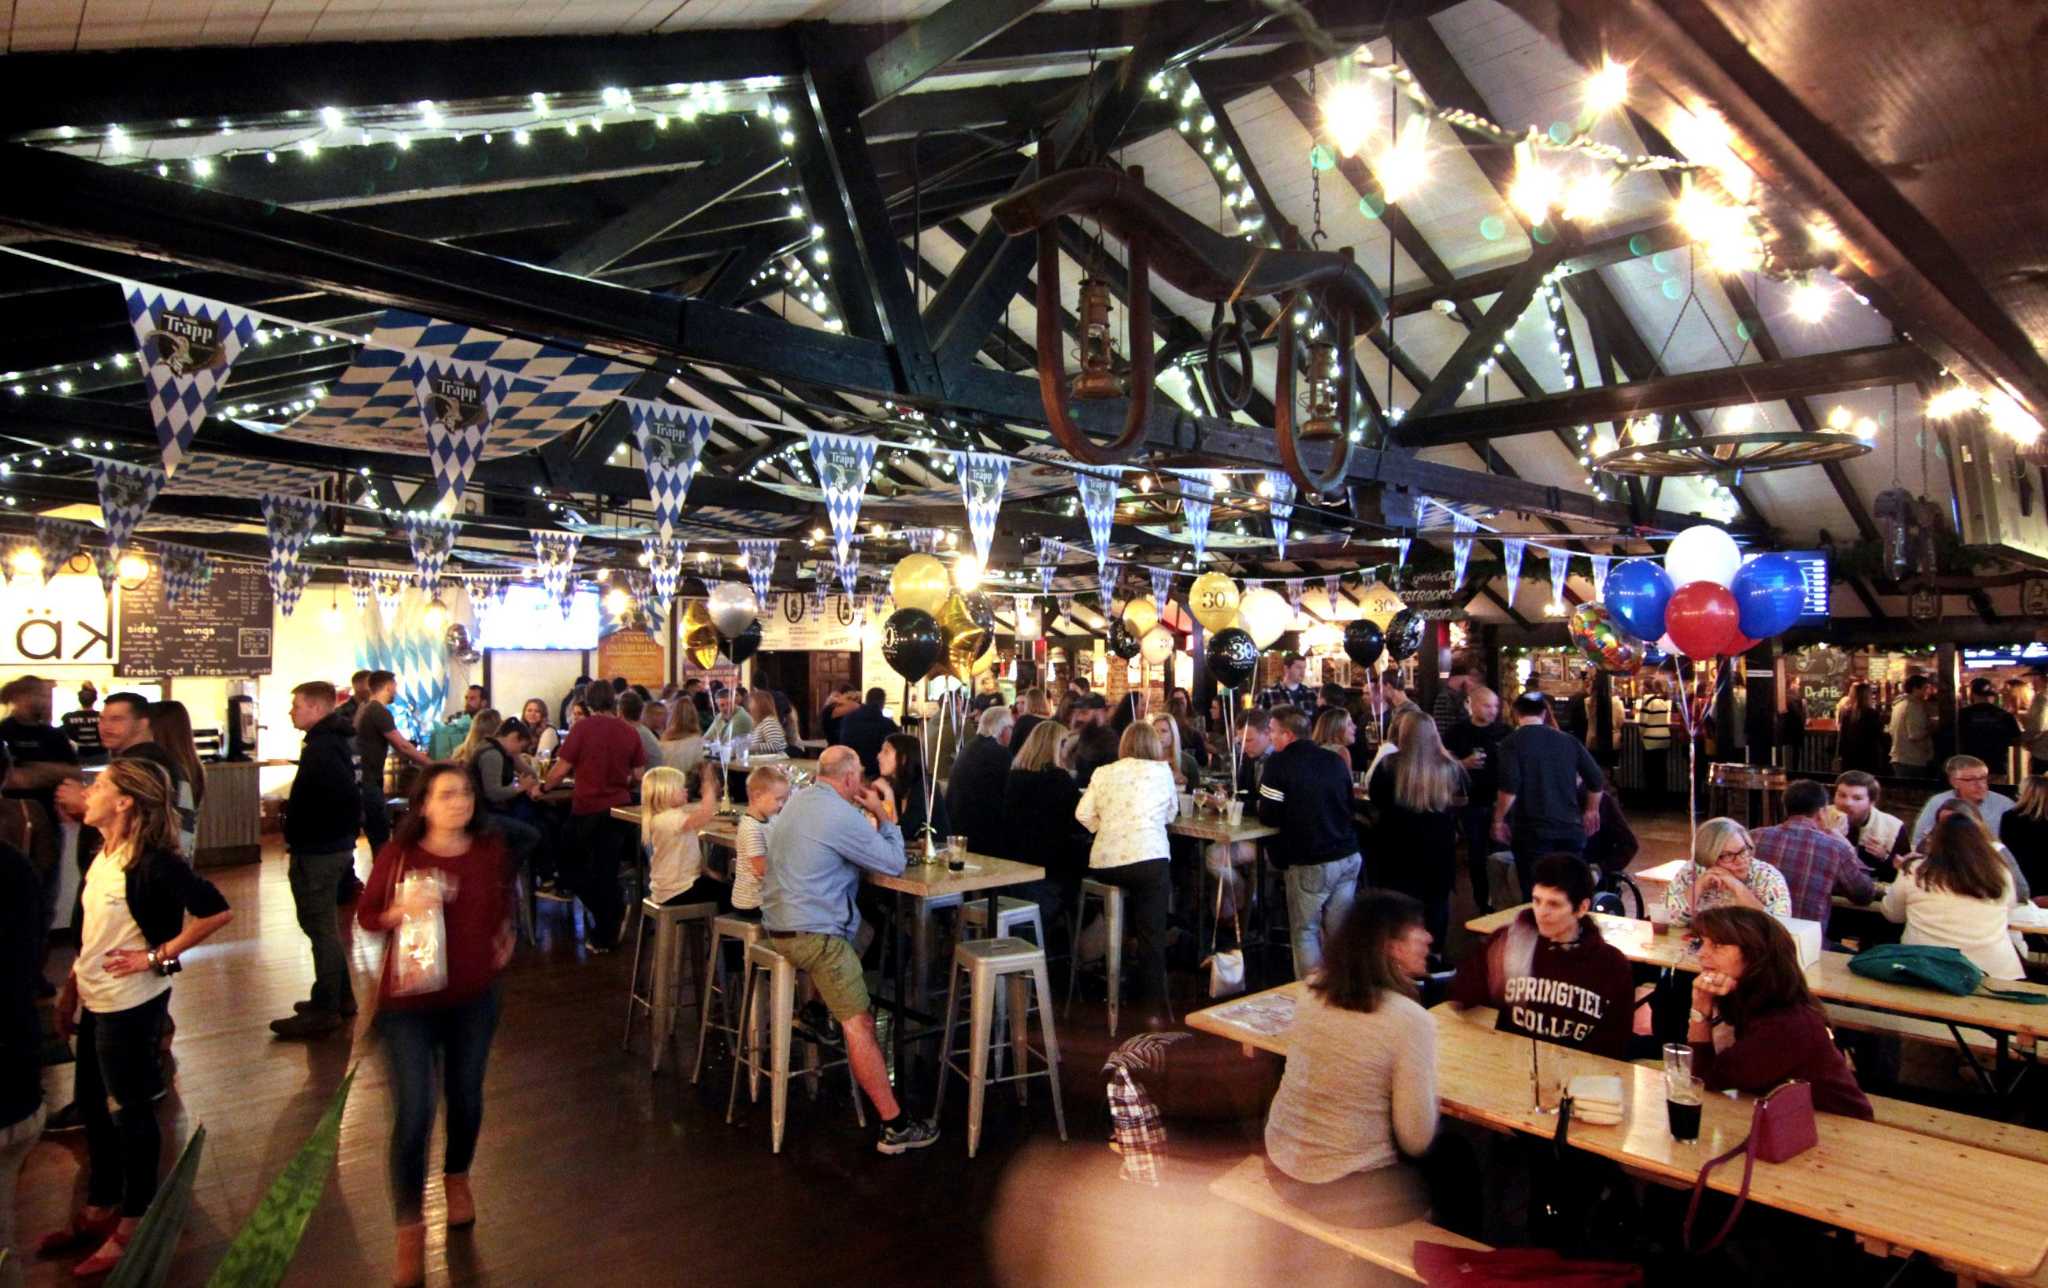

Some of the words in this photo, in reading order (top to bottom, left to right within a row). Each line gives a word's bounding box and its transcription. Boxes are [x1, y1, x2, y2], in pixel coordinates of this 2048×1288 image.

[162, 313, 213, 344] Trapp
[439, 379, 478, 402] Trapp
[653, 421, 687, 443] Trapp
[832, 451, 855, 469] Trapp
[972, 469, 993, 484] Trapp
[1202, 591, 1226, 609] 30
[127, 622, 158, 634] sides
[183, 625, 215, 640] wings
[1232, 642, 1253, 661] 30
[124, 664, 184, 676] fresh-cut
[194, 664, 223, 676] fries
[1504, 976, 1606, 1019] SPRINGFIEL
